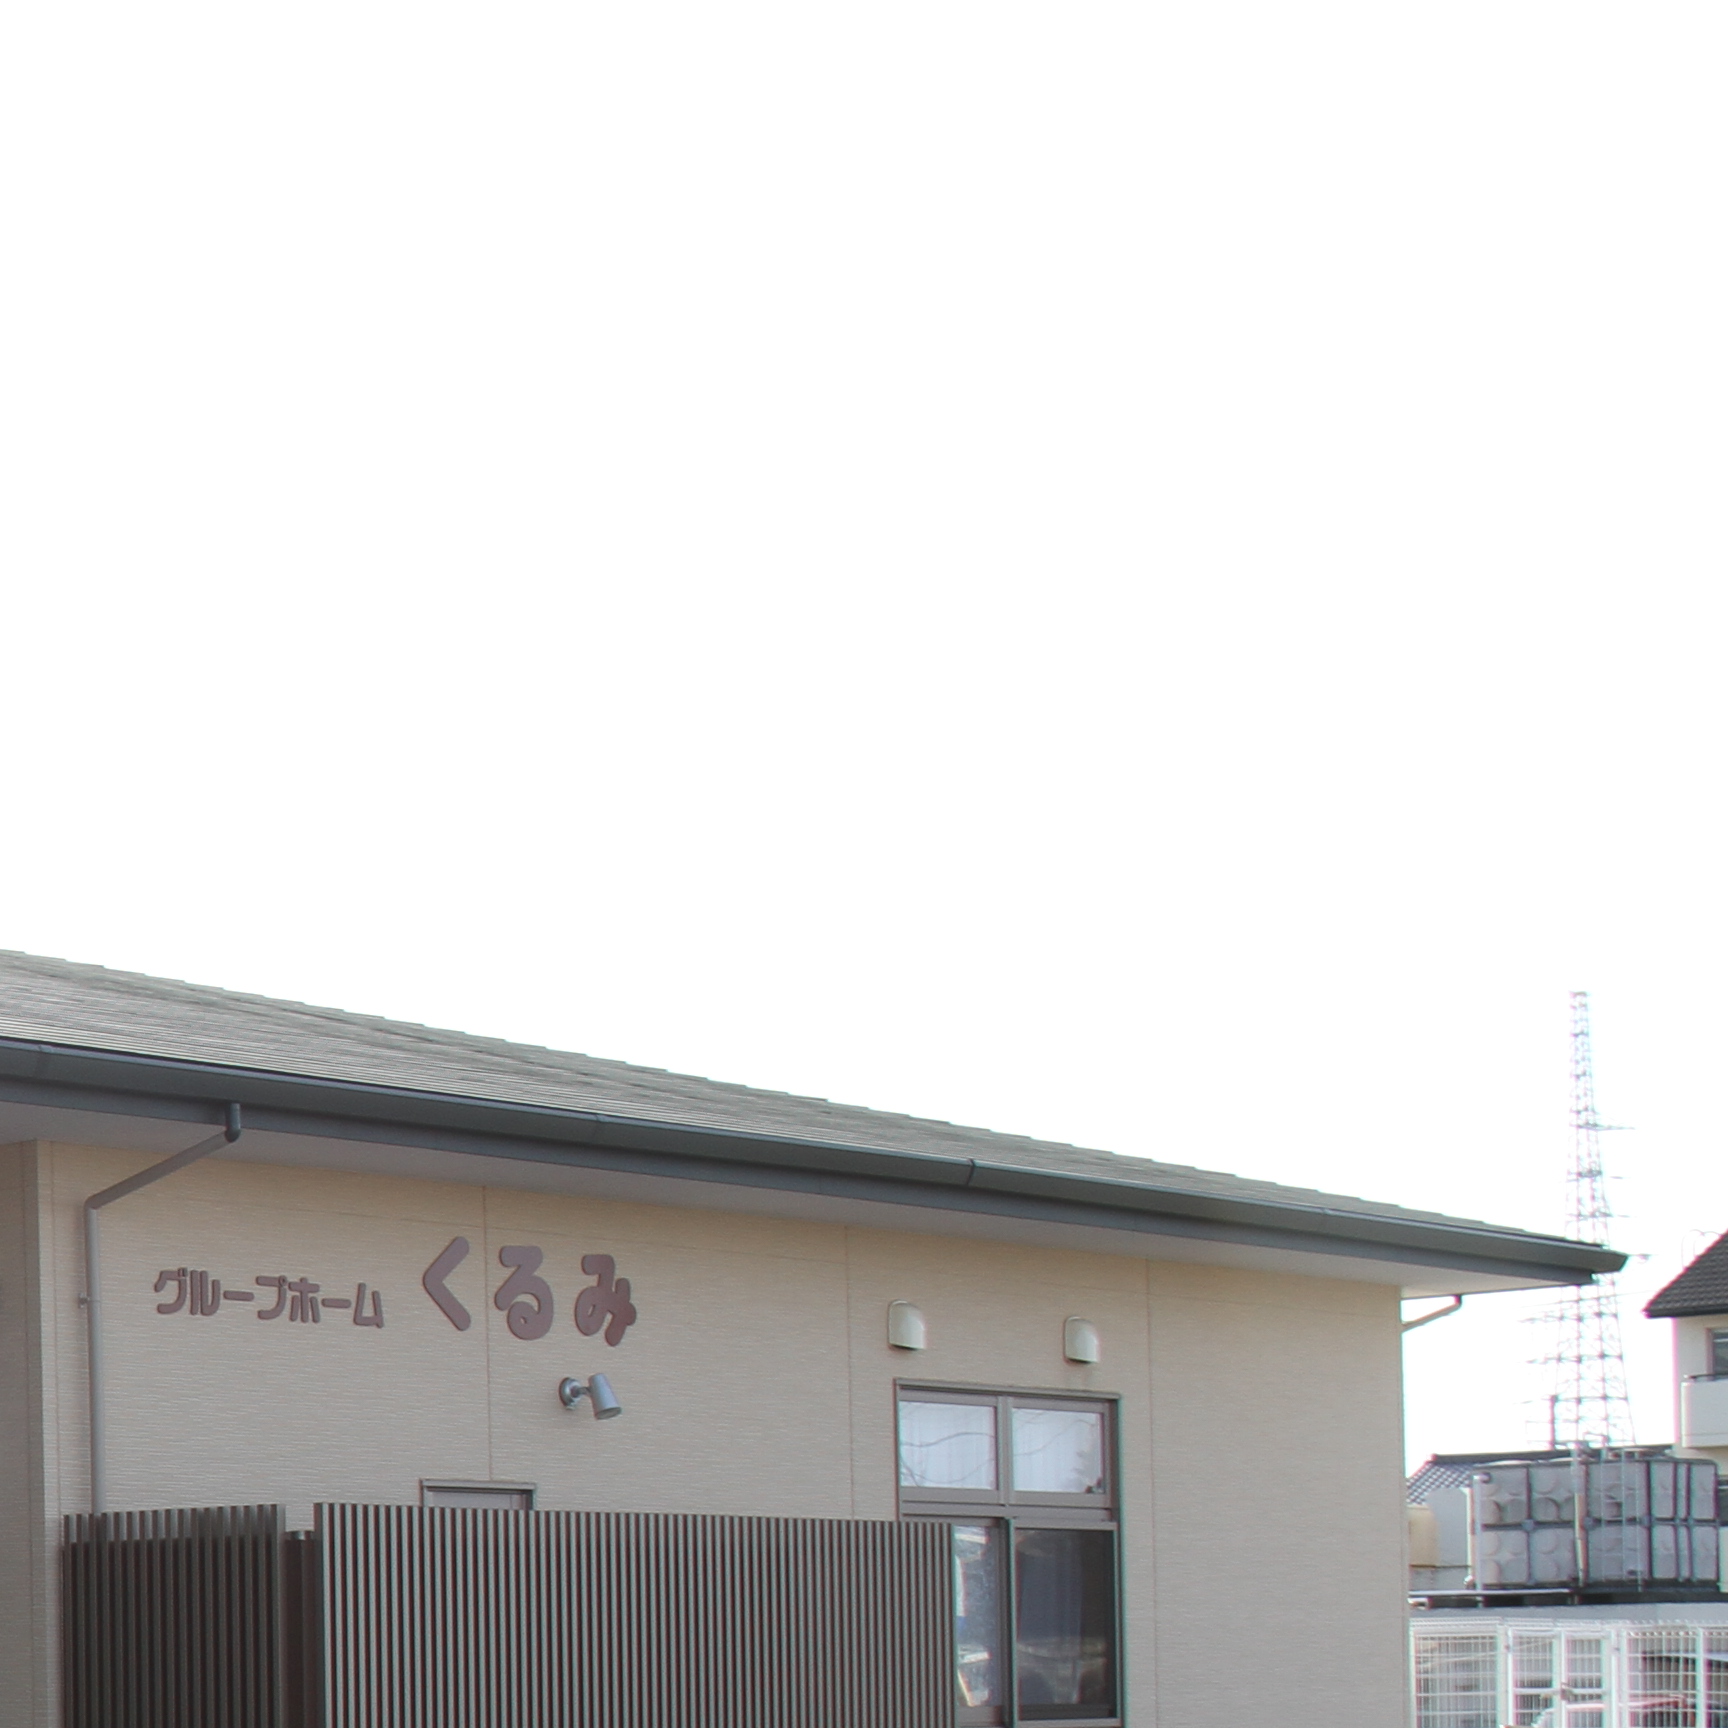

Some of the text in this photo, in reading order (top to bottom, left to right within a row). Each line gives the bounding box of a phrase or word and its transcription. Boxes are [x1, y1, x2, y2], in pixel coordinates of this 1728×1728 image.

[154, 1236, 636, 1346] グループホーム くるみ
